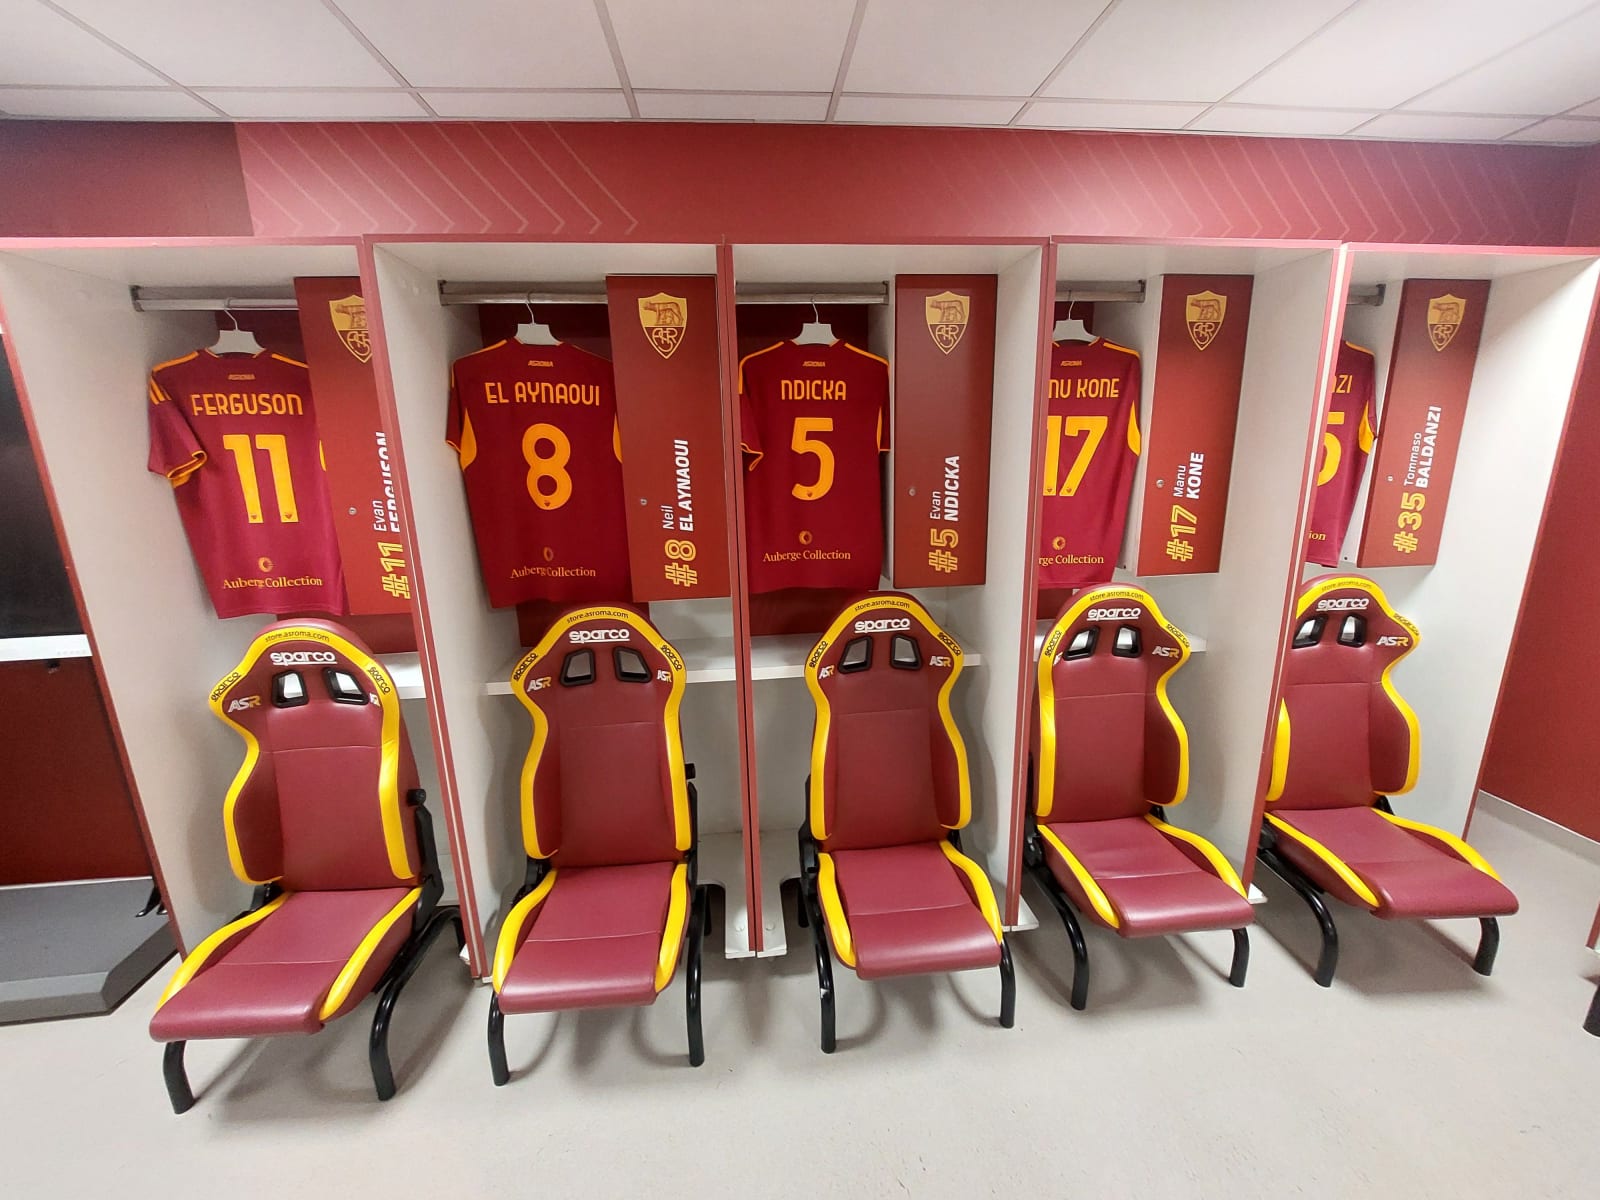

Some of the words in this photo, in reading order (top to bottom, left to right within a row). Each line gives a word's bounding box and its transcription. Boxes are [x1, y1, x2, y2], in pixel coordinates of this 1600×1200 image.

[485, 382, 509, 403] EL
[515, 382, 599, 406] AYNAOUI
[781, 380, 846, 401] NDICKA
[1077, 378, 1119, 398] KONE
[191, 393, 303, 416] FERGUSON
[1043, 416, 1108, 496] 17
[1415, 405, 1442, 489] BALDANZI
[522, 423, 572, 510] 8
[791, 417, 835, 500] 5
[1404, 432, 1422, 486] Tommaso
[222, 434, 299, 523] 11
[674, 439, 693, 508] AYNAOUI
[1173, 464, 1187, 498] Manu
[1186, 452, 1204, 500] KONE
[944, 455, 960, 522] NDICKA
[372, 500, 387, 532] Evan
[929, 491, 941, 520] Evan
[662, 504, 674, 530] Neil
[679, 513, 694, 532] EL
[1393, 492, 1426, 554] #35
[1166, 504, 1198, 562] #17
[762, 550, 801, 563] Auberge
[803, 548, 851, 561] Collection
[928, 528, 959, 573] #5
[1055, 553, 1105, 564] Collection
[377, 541, 411, 599] #11
[664, 539, 697, 587] #8
[264, 575, 323, 588] Collection
[855, 600, 909, 611] store.asroma.com
[1090, 591, 1144, 601] store.asroma.com
[1316, 598, 1369, 611] sparco
[567, 610, 628, 623] store.asroma.com
[855, 618, 910, 633] sparco
[1087, 608, 1141, 621] sparco
[265, 630, 329, 642] store.asroma.com
[569, 629, 630, 643] sparco
[1376, 636, 1408, 646] ASR
[270, 651, 338, 666] sparco
[929, 655, 951, 667] ASR
[1152, 646, 1178, 658] ASR
[514, 653, 538, 681] sparco
[657, 670, 672, 682] ASR
[819, 665, 835, 679] ASR
[211, 672, 240, 702] sparco
[527, 677, 551, 692] ASR
[228, 696, 261, 713] ASR
